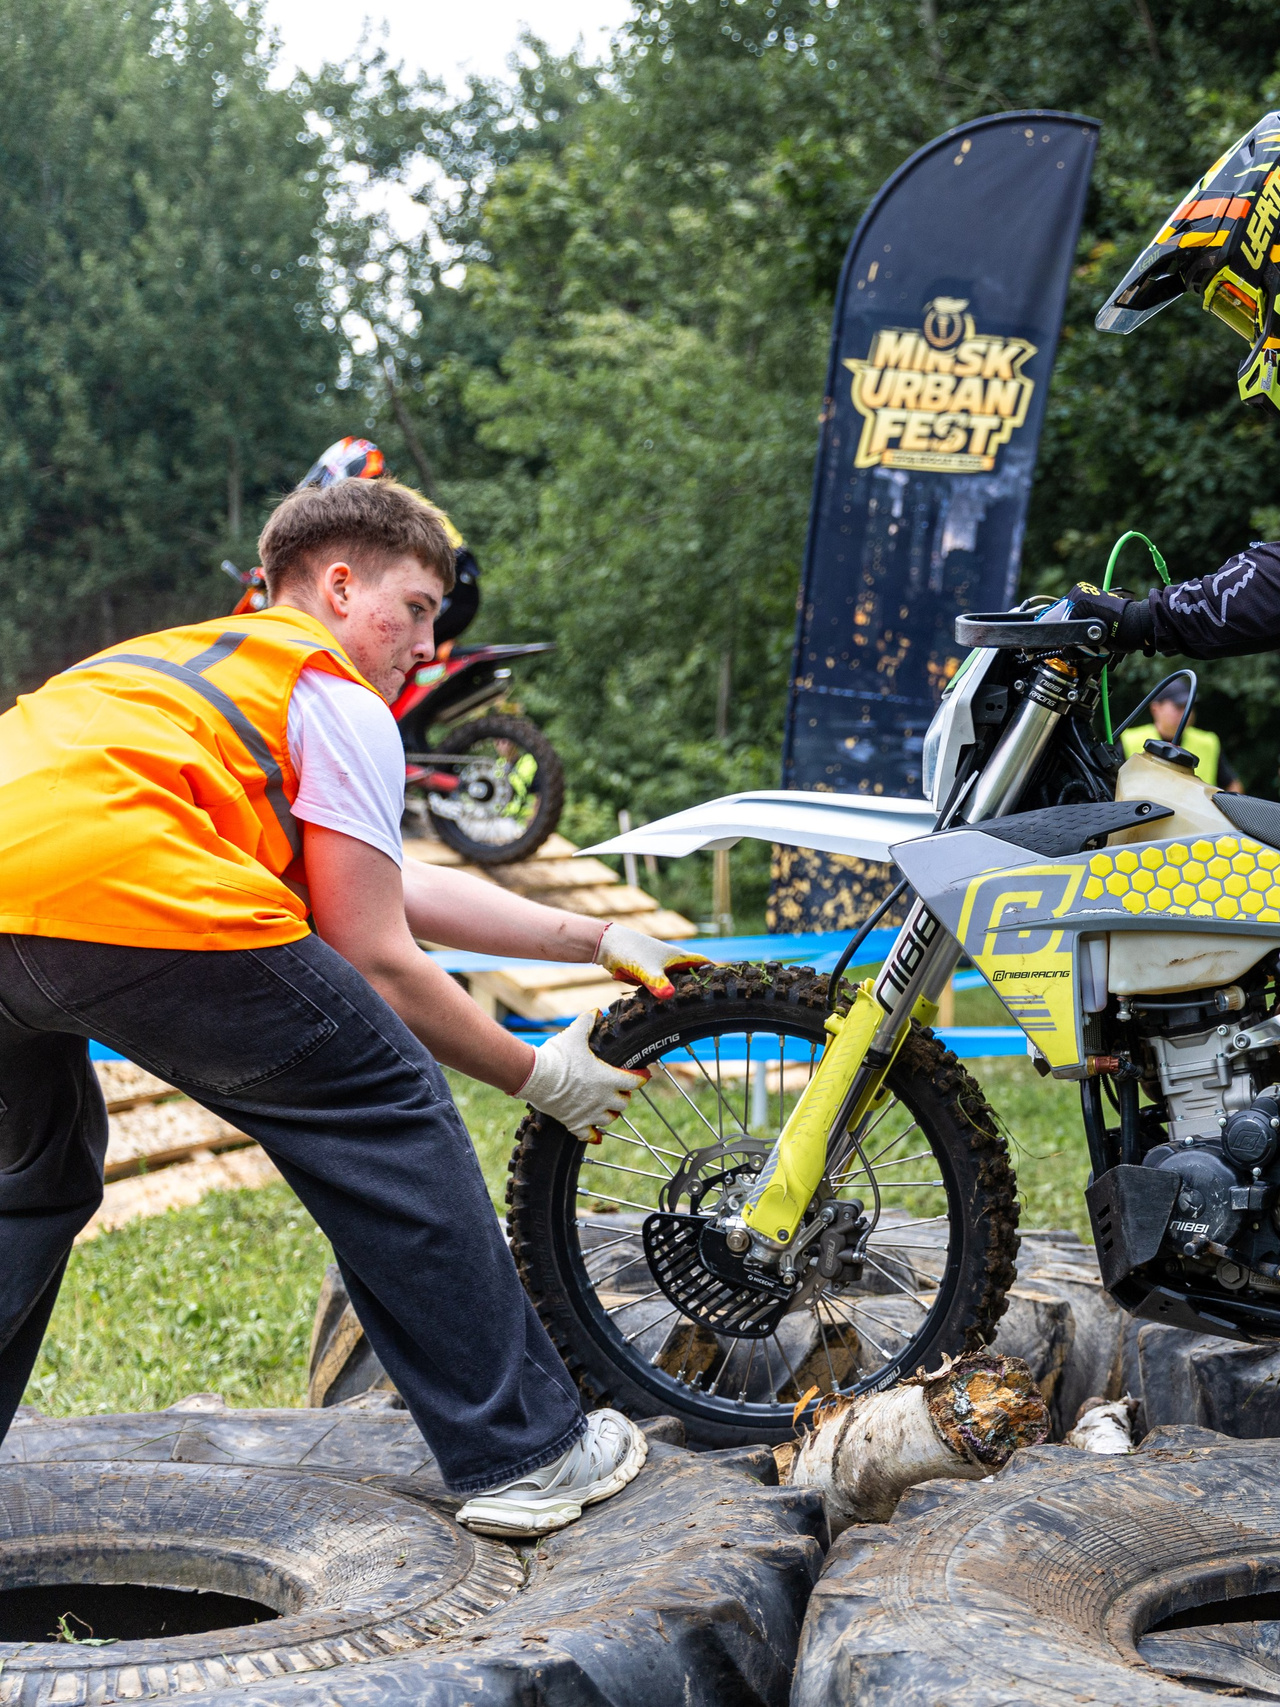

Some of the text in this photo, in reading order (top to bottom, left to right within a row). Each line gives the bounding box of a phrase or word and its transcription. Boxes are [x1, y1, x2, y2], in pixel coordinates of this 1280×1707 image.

[1138, 248, 1161, 273] LEATT
[873, 330, 1023, 380] MINSK
[861, 369, 1021, 417] URBAN
[870, 408, 1001, 456] FEST
[1029, 690, 1057, 707] RACING
[876, 903, 941, 1015] NIBB
[1004, 971, 1031, 979] NIBBI
[641, 1033, 680, 1058] RACING
[1169, 1220, 1210, 1233] NIBBI
[825, 1239, 836, 1271] NIBBI
[878, 1366, 901, 1391] NIBBI
